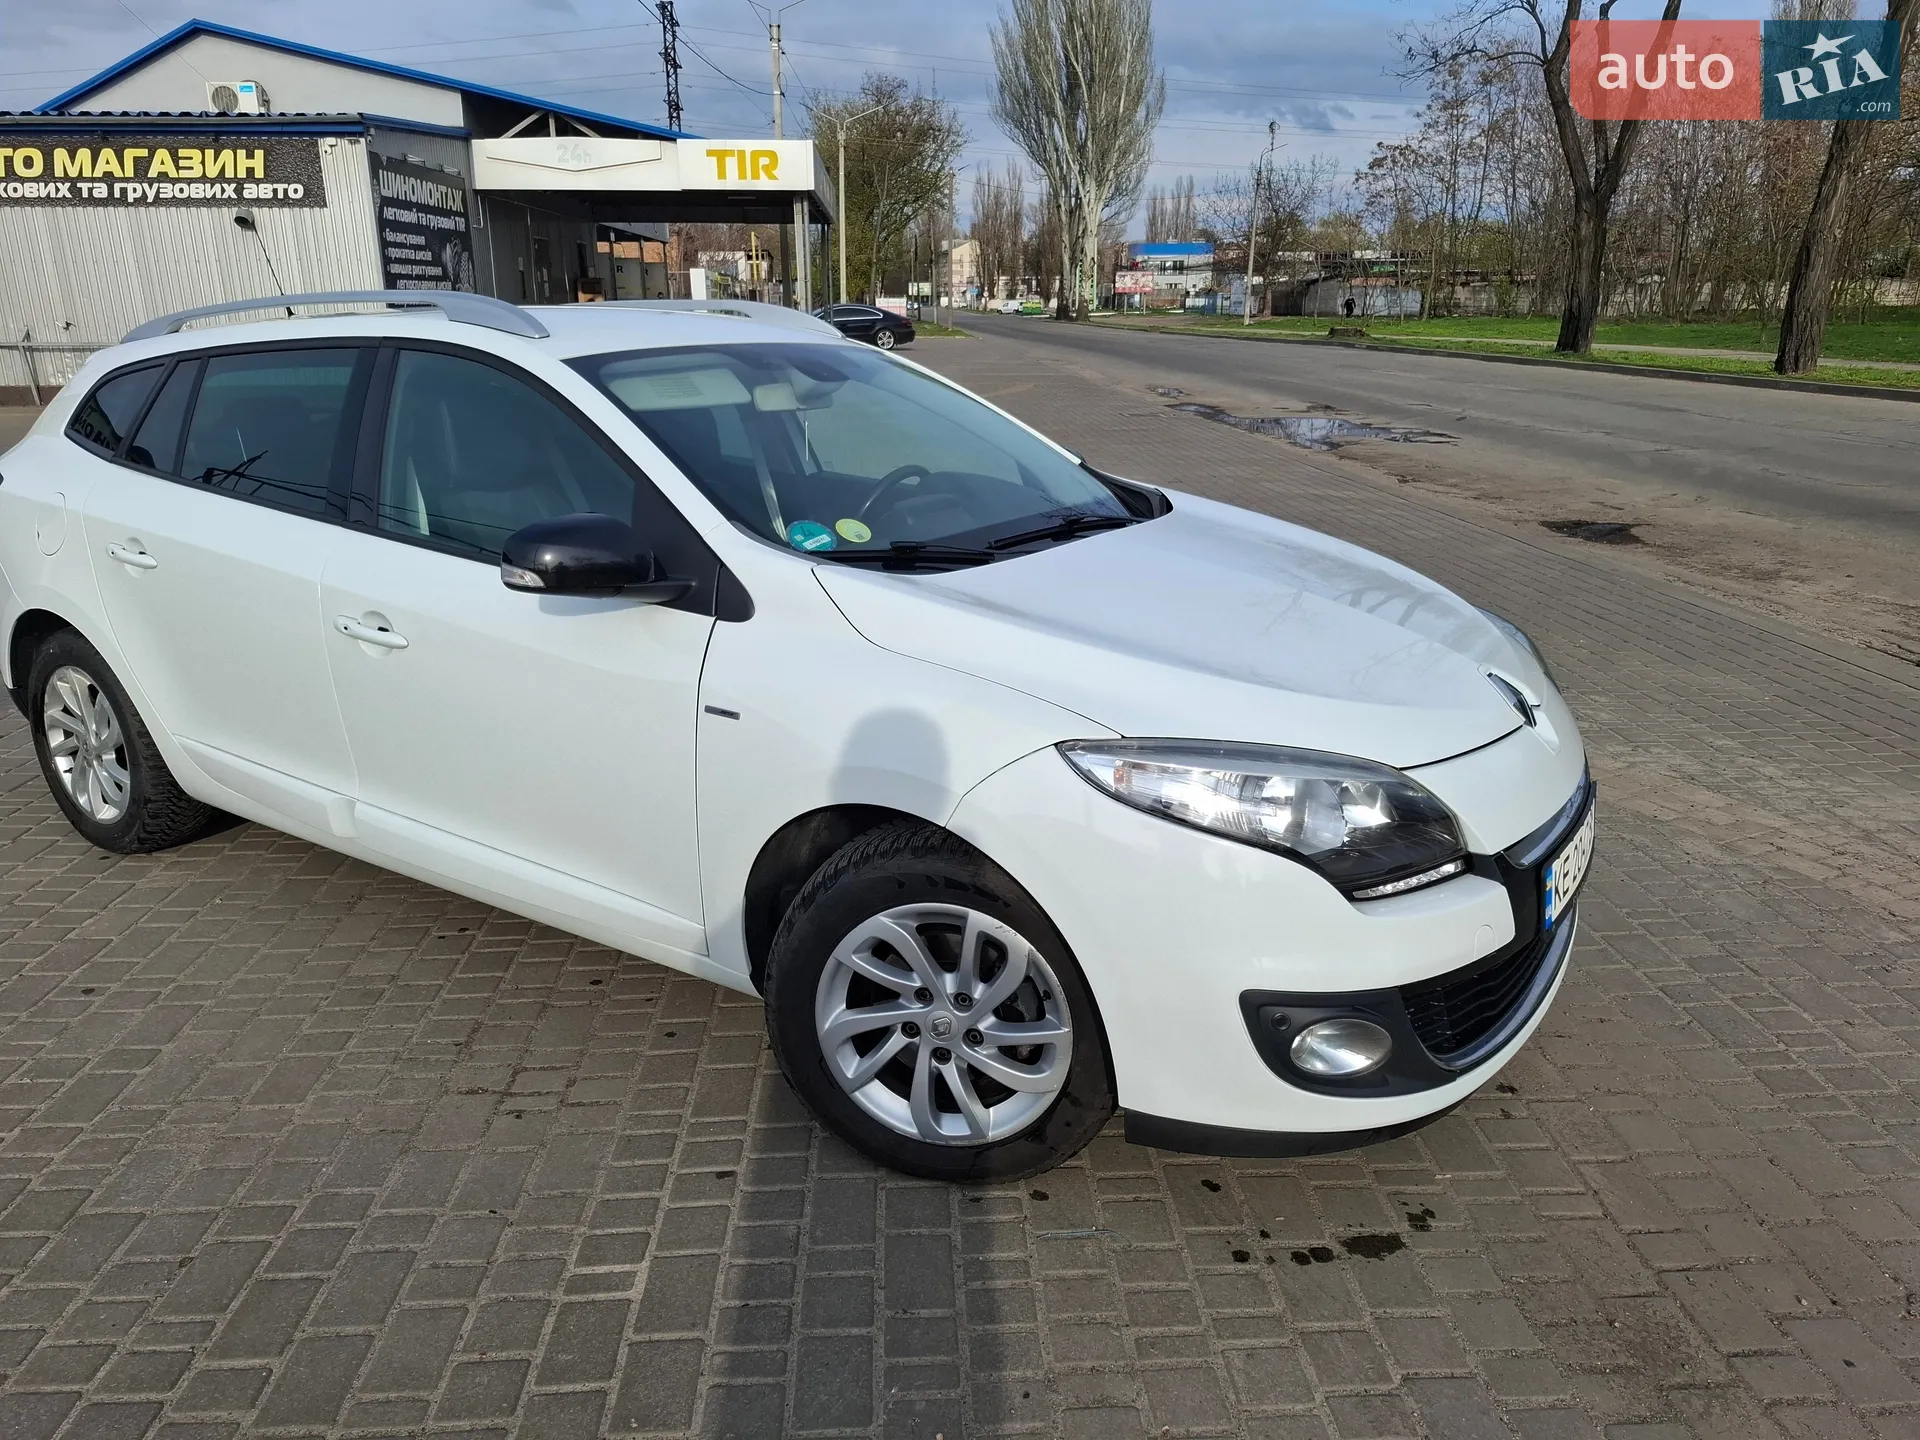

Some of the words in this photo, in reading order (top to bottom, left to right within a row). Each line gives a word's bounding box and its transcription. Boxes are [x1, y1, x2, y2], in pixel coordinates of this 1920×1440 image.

[53, 147, 264, 178] МАГАЗИН
[706, 149, 779, 181] TIR
[77, 183, 108, 198] та
[113, 183, 237, 202] грузових
[243, 183, 304, 199] авто
[379, 169, 464, 213] ШИНОМОНТАЖ
[427, 214, 455, 231] грузовий
